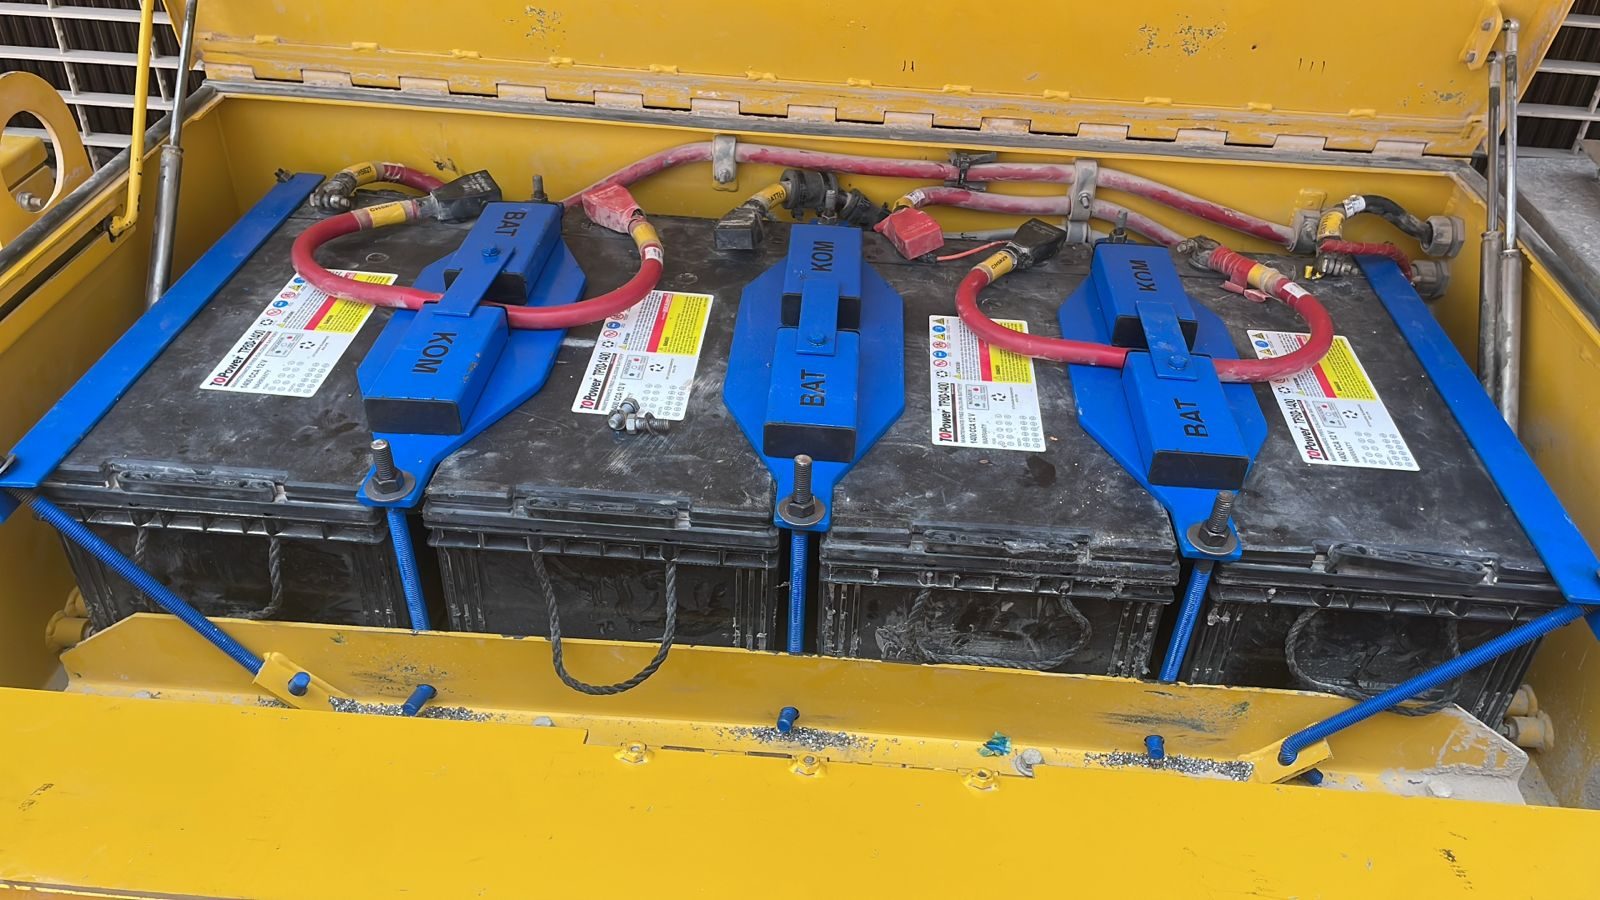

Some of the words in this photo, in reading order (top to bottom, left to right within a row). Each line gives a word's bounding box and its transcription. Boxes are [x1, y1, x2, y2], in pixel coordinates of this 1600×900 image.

[494, 211, 527, 237] BAT
[811, 241, 834, 272] KOM
[1129, 259, 1157, 291] KOM
[412, 332, 457, 374] KOM
[209, 356, 246, 386] TOPower
[579, 378, 603, 409] TOPower
[800, 369, 826, 407] BAT
[609, 402, 619, 411] 400
[1174, 398, 1209, 438] BAT
[939, 410, 952, 442] TOPower
[970, 433, 978, 443] 1400
[1301, 427, 1323, 460] TOPower
